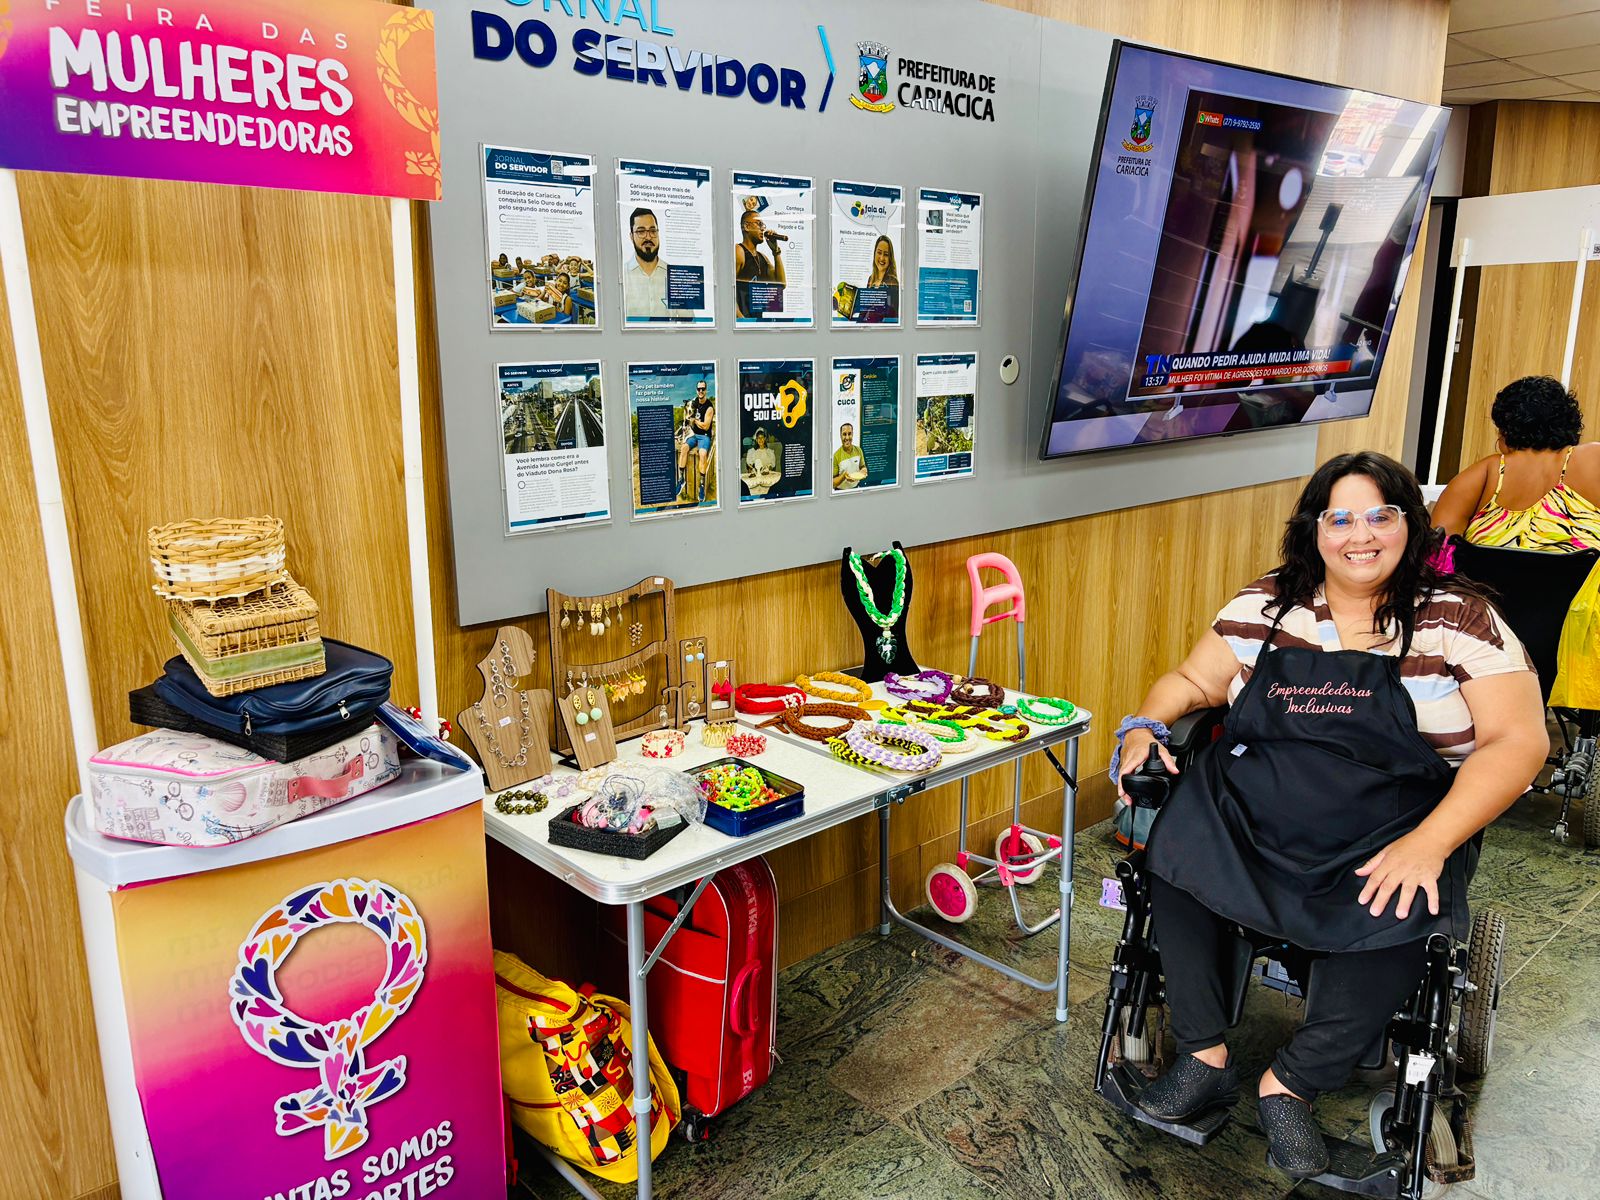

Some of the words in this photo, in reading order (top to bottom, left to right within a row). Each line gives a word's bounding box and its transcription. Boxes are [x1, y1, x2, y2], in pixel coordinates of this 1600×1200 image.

[46, 0, 213, 32] FEIRA
[262, 22, 348, 50] DAS
[471, 10, 557, 68] DO
[572, 28, 806, 110] SERVIDOR
[49, 26, 353, 116] MULHERES
[898, 58, 977, 90] PREFEITURA
[979, 74, 996, 93] DE
[898, 82, 995, 122] CARIACICA
[56, 97, 353, 156] EMPREENDEDORAS
[1205, 115, 1220, 124] Whats
[1223, 118, 1232, 126] (27)
[494, 154, 524, 164] JORNAL
[1118, 156, 1144, 165] PREFEITURA
[509, 164, 548, 174] SERVIDOR
[1116, 165, 1148, 176] CARIACICA
[498, 189, 526, 198] Educação
[512, 206, 538, 214] segundo
[865, 204, 877, 214] fala
[1146, 354, 1171, 375] TN
[1172, 357, 1210, 370] QUANDO
[1212, 354, 1238, 366] PEDIR
[1239, 353, 1266, 365] AJUDA
[1268, 351, 1291, 363] MUDA
[1292, 350, 1310, 362] UMA
[1311, 348, 1331, 360] VIDA!
[1145, 376, 1164, 387] 13:37
[1168, 374, 1192, 384] MULHER
[1194, 373, 1203, 382] FOI
[1263, 368, 1271, 376] DO
[1272, 367, 1292, 376] MARIDO
[744, 393, 782, 411] QUEM
[754, 410, 769, 421] SOU
[771, 410, 782, 420] EU
[1267, 682, 1373, 700] Empreendedoras
[1285, 697, 1354, 714] Inclusivas
[362, 1120, 454, 1184] SOMOS
